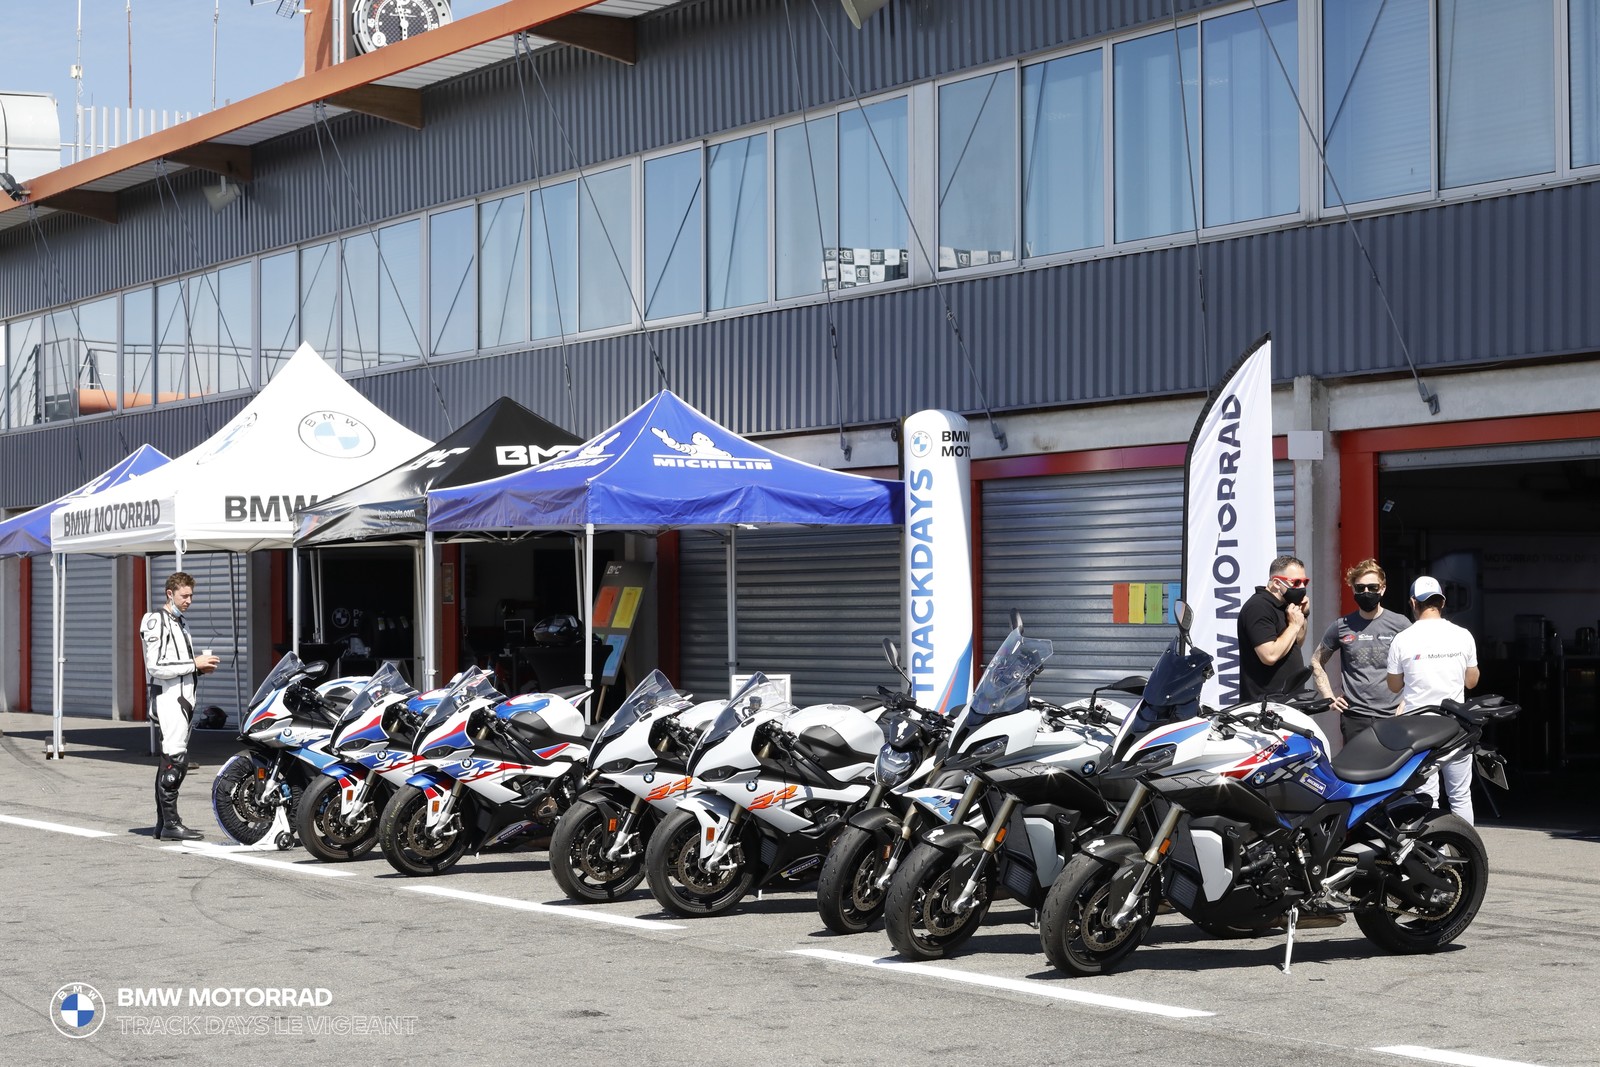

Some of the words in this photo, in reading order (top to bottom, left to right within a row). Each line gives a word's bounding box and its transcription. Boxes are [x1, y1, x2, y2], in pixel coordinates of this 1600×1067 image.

[304, 413, 358, 428] BMW
[652, 457, 773, 470] MICHELIN
[63, 508, 91, 537] BMW
[94, 498, 161, 533] MOTORRAD
[1212, 394, 1242, 620] MOTORRAD
[910, 468, 934, 698] TRACKDAYS
[1216, 633, 1241, 706] MW
[1427, 651, 1462, 660] Motorsport
